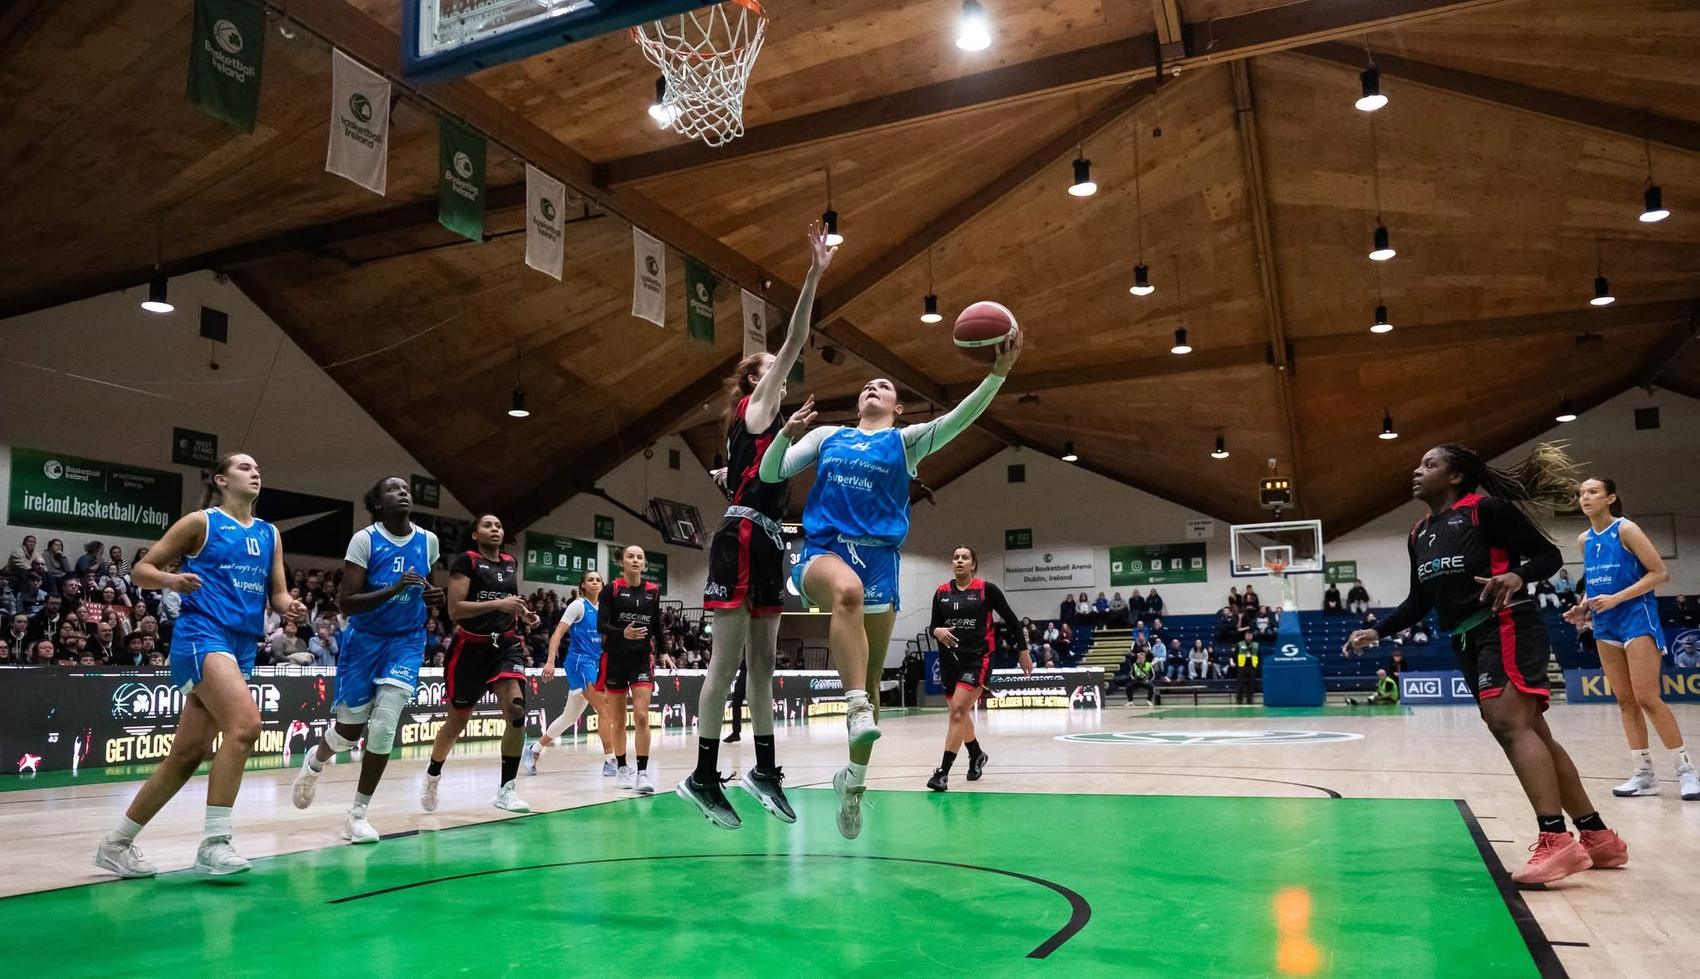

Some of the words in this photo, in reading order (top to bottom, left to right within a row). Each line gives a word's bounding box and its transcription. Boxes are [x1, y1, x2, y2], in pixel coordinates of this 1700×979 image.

[212, 58, 245, 84] Ireland
[345, 127, 374, 149] Ireland
[65, 465, 101, 477] Basketball
[65, 473, 89, 481] Ireland
[827, 471, 873, 488] SuperValu
[24, 489, 169, 530] ireland.basketball/shop
[246, 537, 260, 556] 10
[1429, 533, 1436, 547] 7
[1595, 543, 1601, 558] 7
[392, 556, 405, 573] 51
[1006, 565, 1034, 574] National
[1035, 564, 1070, 572] Basketball
[497, 573, 504, 582] 8
[1024, 575, 1048, 583] Dublin,
[1048, 574, 1073, 582] Ireland
[636, 599, 640, 607] 1
[953, 602, 959, 610] 11
[1408, 682, 1436, 693] AIG
[401, 723, 420, 744] GET
[106, 736, 136, 763] GET
[136, 733, 175, 759] CLOS
